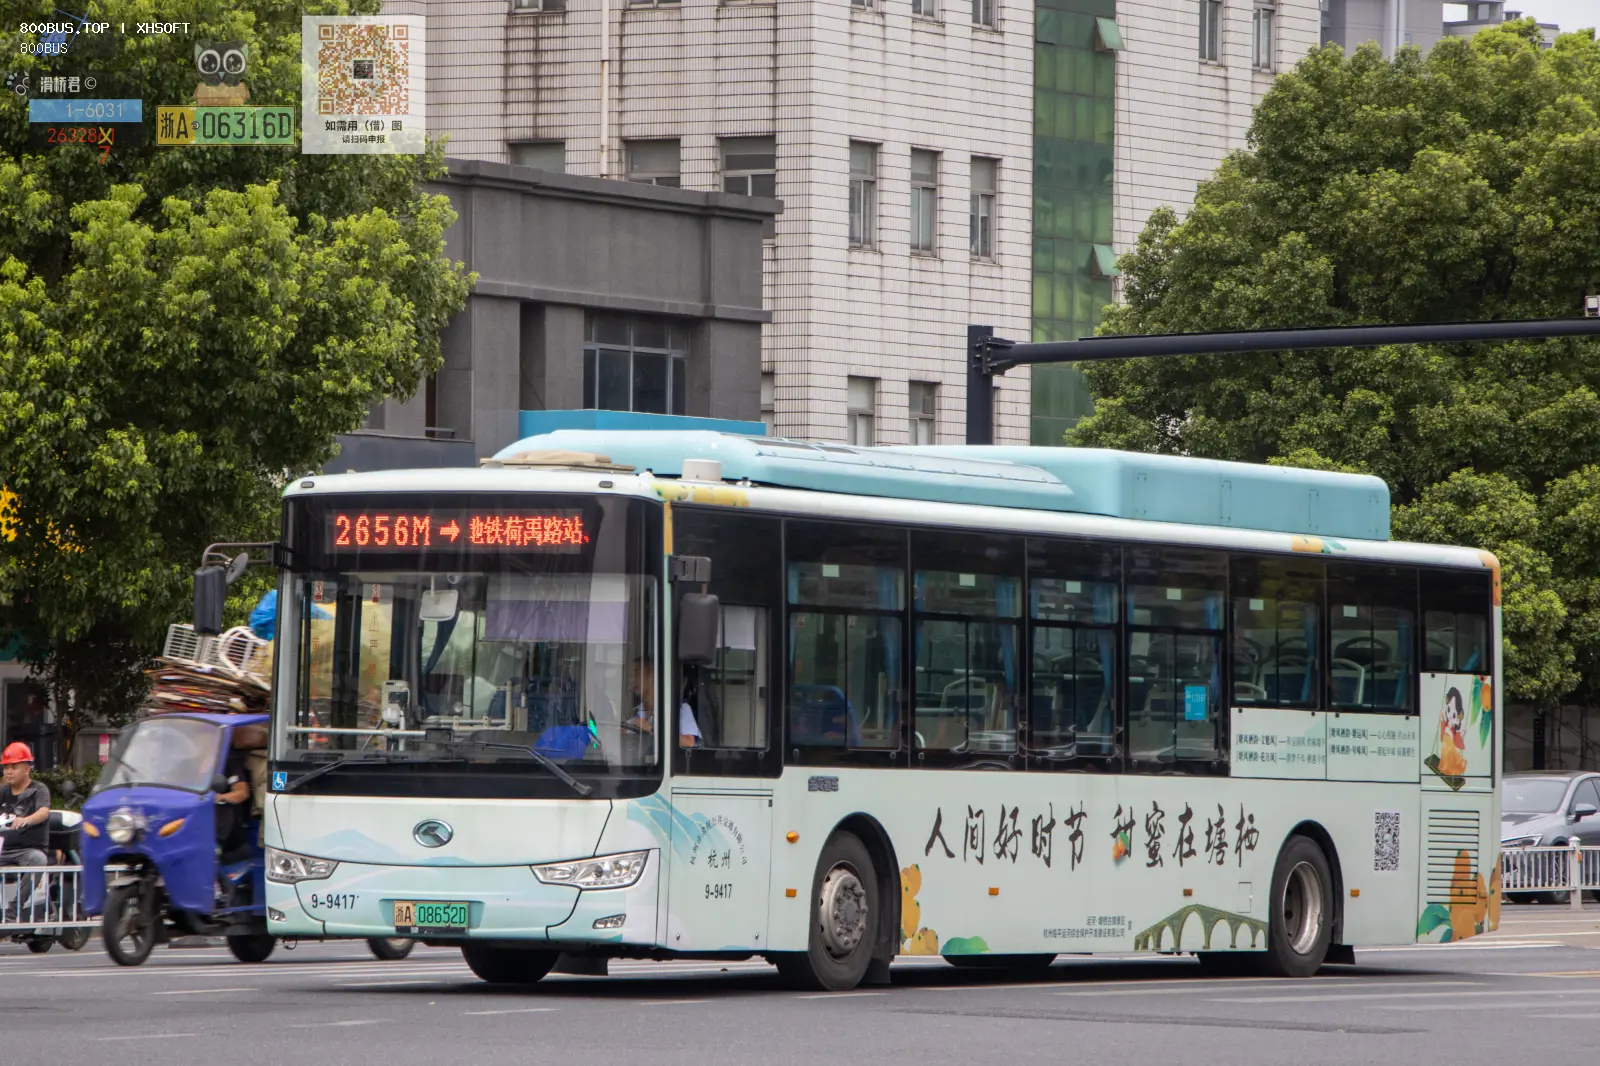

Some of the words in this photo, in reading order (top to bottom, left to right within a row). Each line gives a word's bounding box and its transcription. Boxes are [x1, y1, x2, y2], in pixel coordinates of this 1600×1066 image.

[335, 515, 431, 546] 2656M
[469, 515, 584, 546] 地铁荷禹路站
[924, 800, 1089, 871] 人间好时节
[1110, 800, 1260, 868] 甜蜜在塘栖
[708, 849, 731, 870] 杭州
[311, 893, 356, 910] 9-9417
[705, 883, 732, 899] 9-9417
